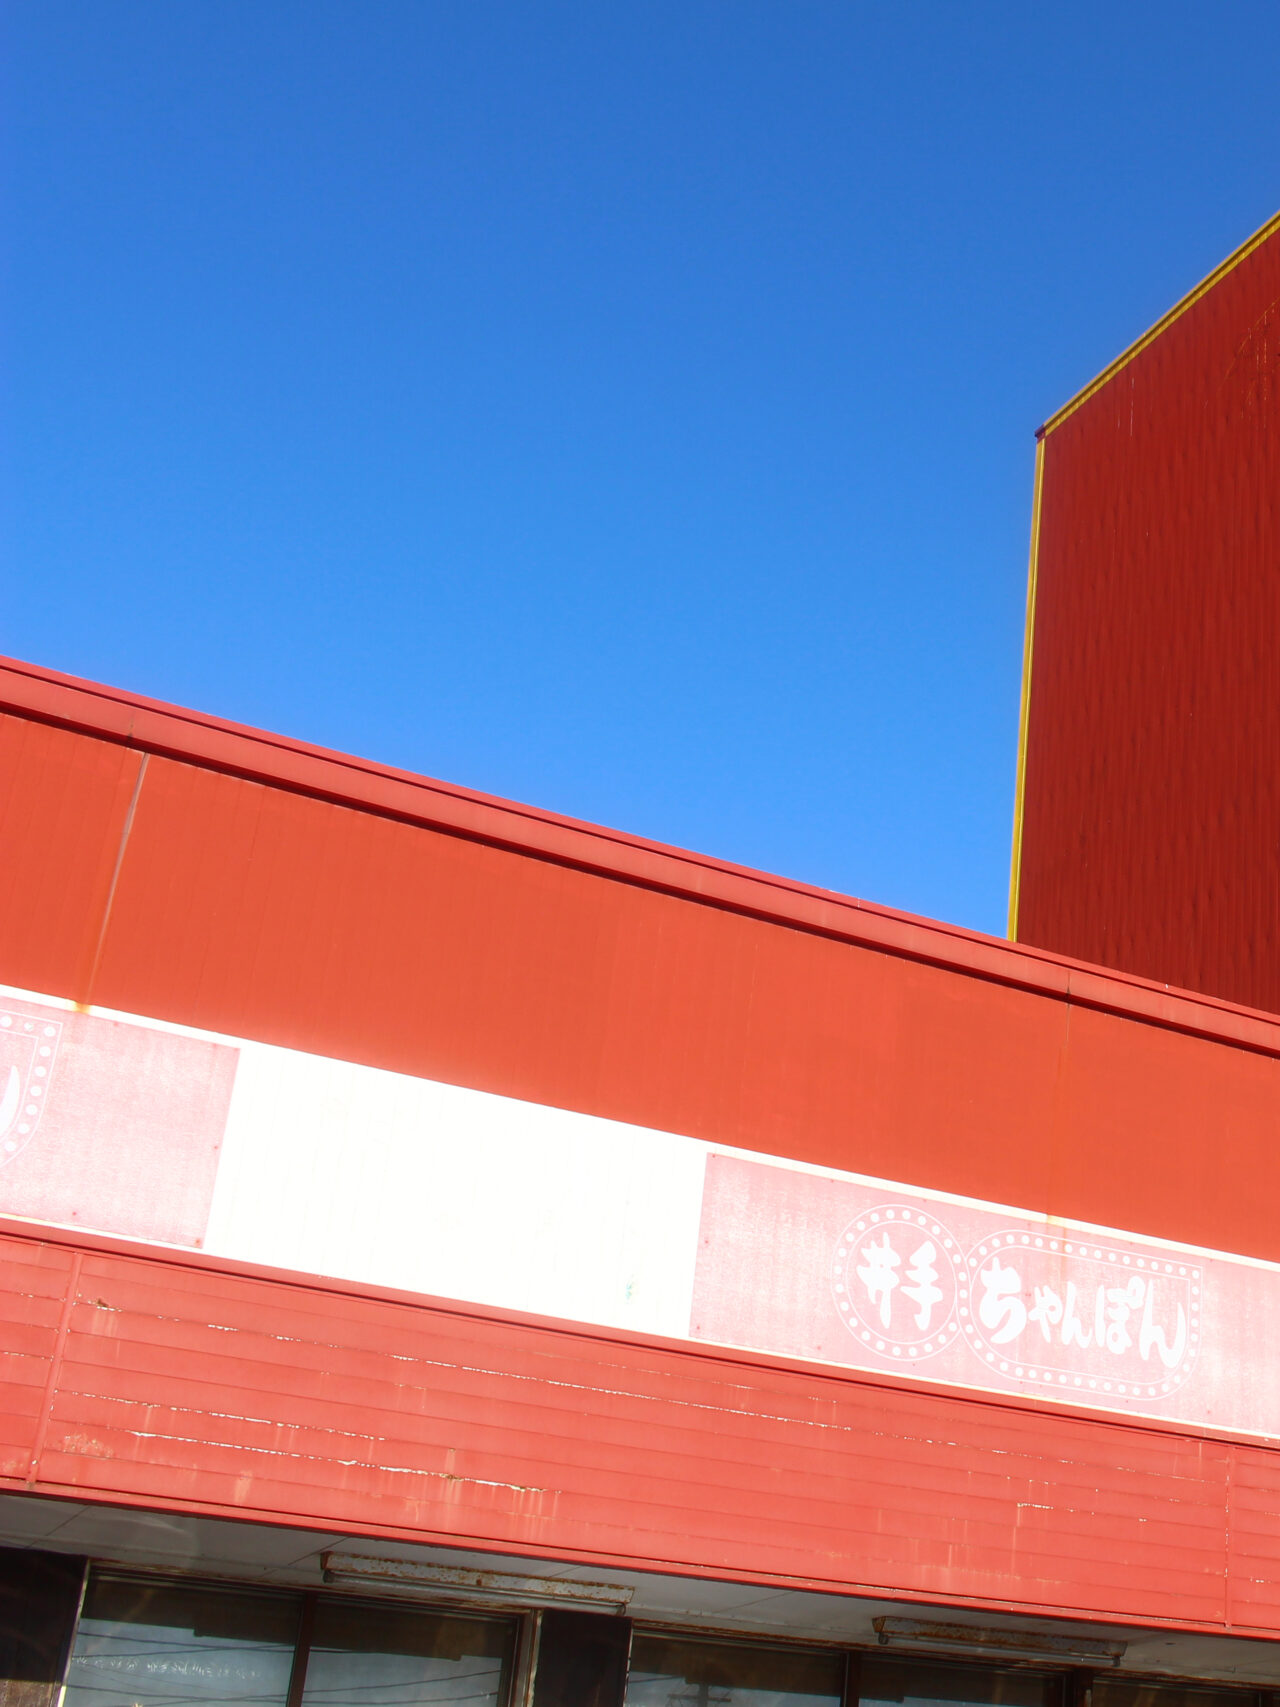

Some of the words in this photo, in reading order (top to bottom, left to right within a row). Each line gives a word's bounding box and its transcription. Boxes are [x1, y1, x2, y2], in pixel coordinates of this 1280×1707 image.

[978, 1256, 1188, 1369] ちゃんぽん
